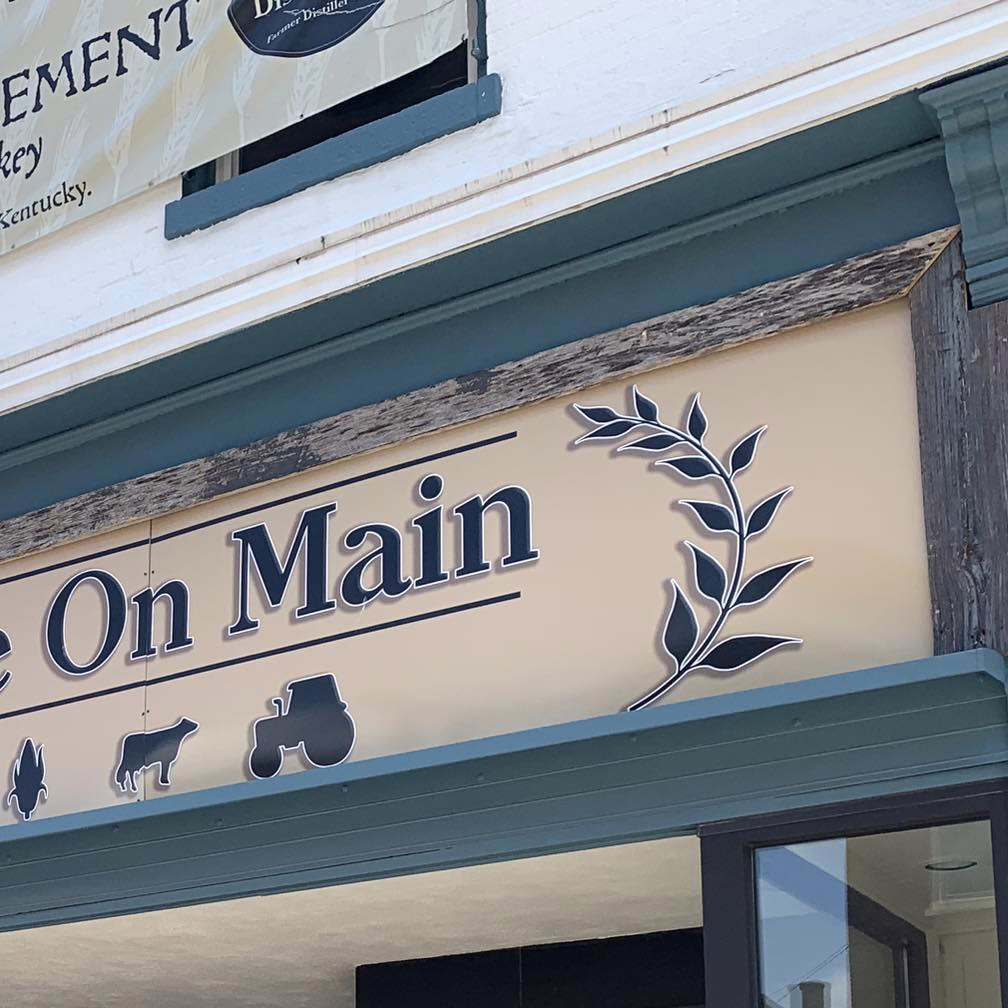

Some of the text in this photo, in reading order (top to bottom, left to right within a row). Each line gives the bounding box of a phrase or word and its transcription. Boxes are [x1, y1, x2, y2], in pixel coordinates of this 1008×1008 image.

[266, 17, 302, 45] Farmer
[44, 567, 194, 676] On
[225, 472, 539, 637] Main
